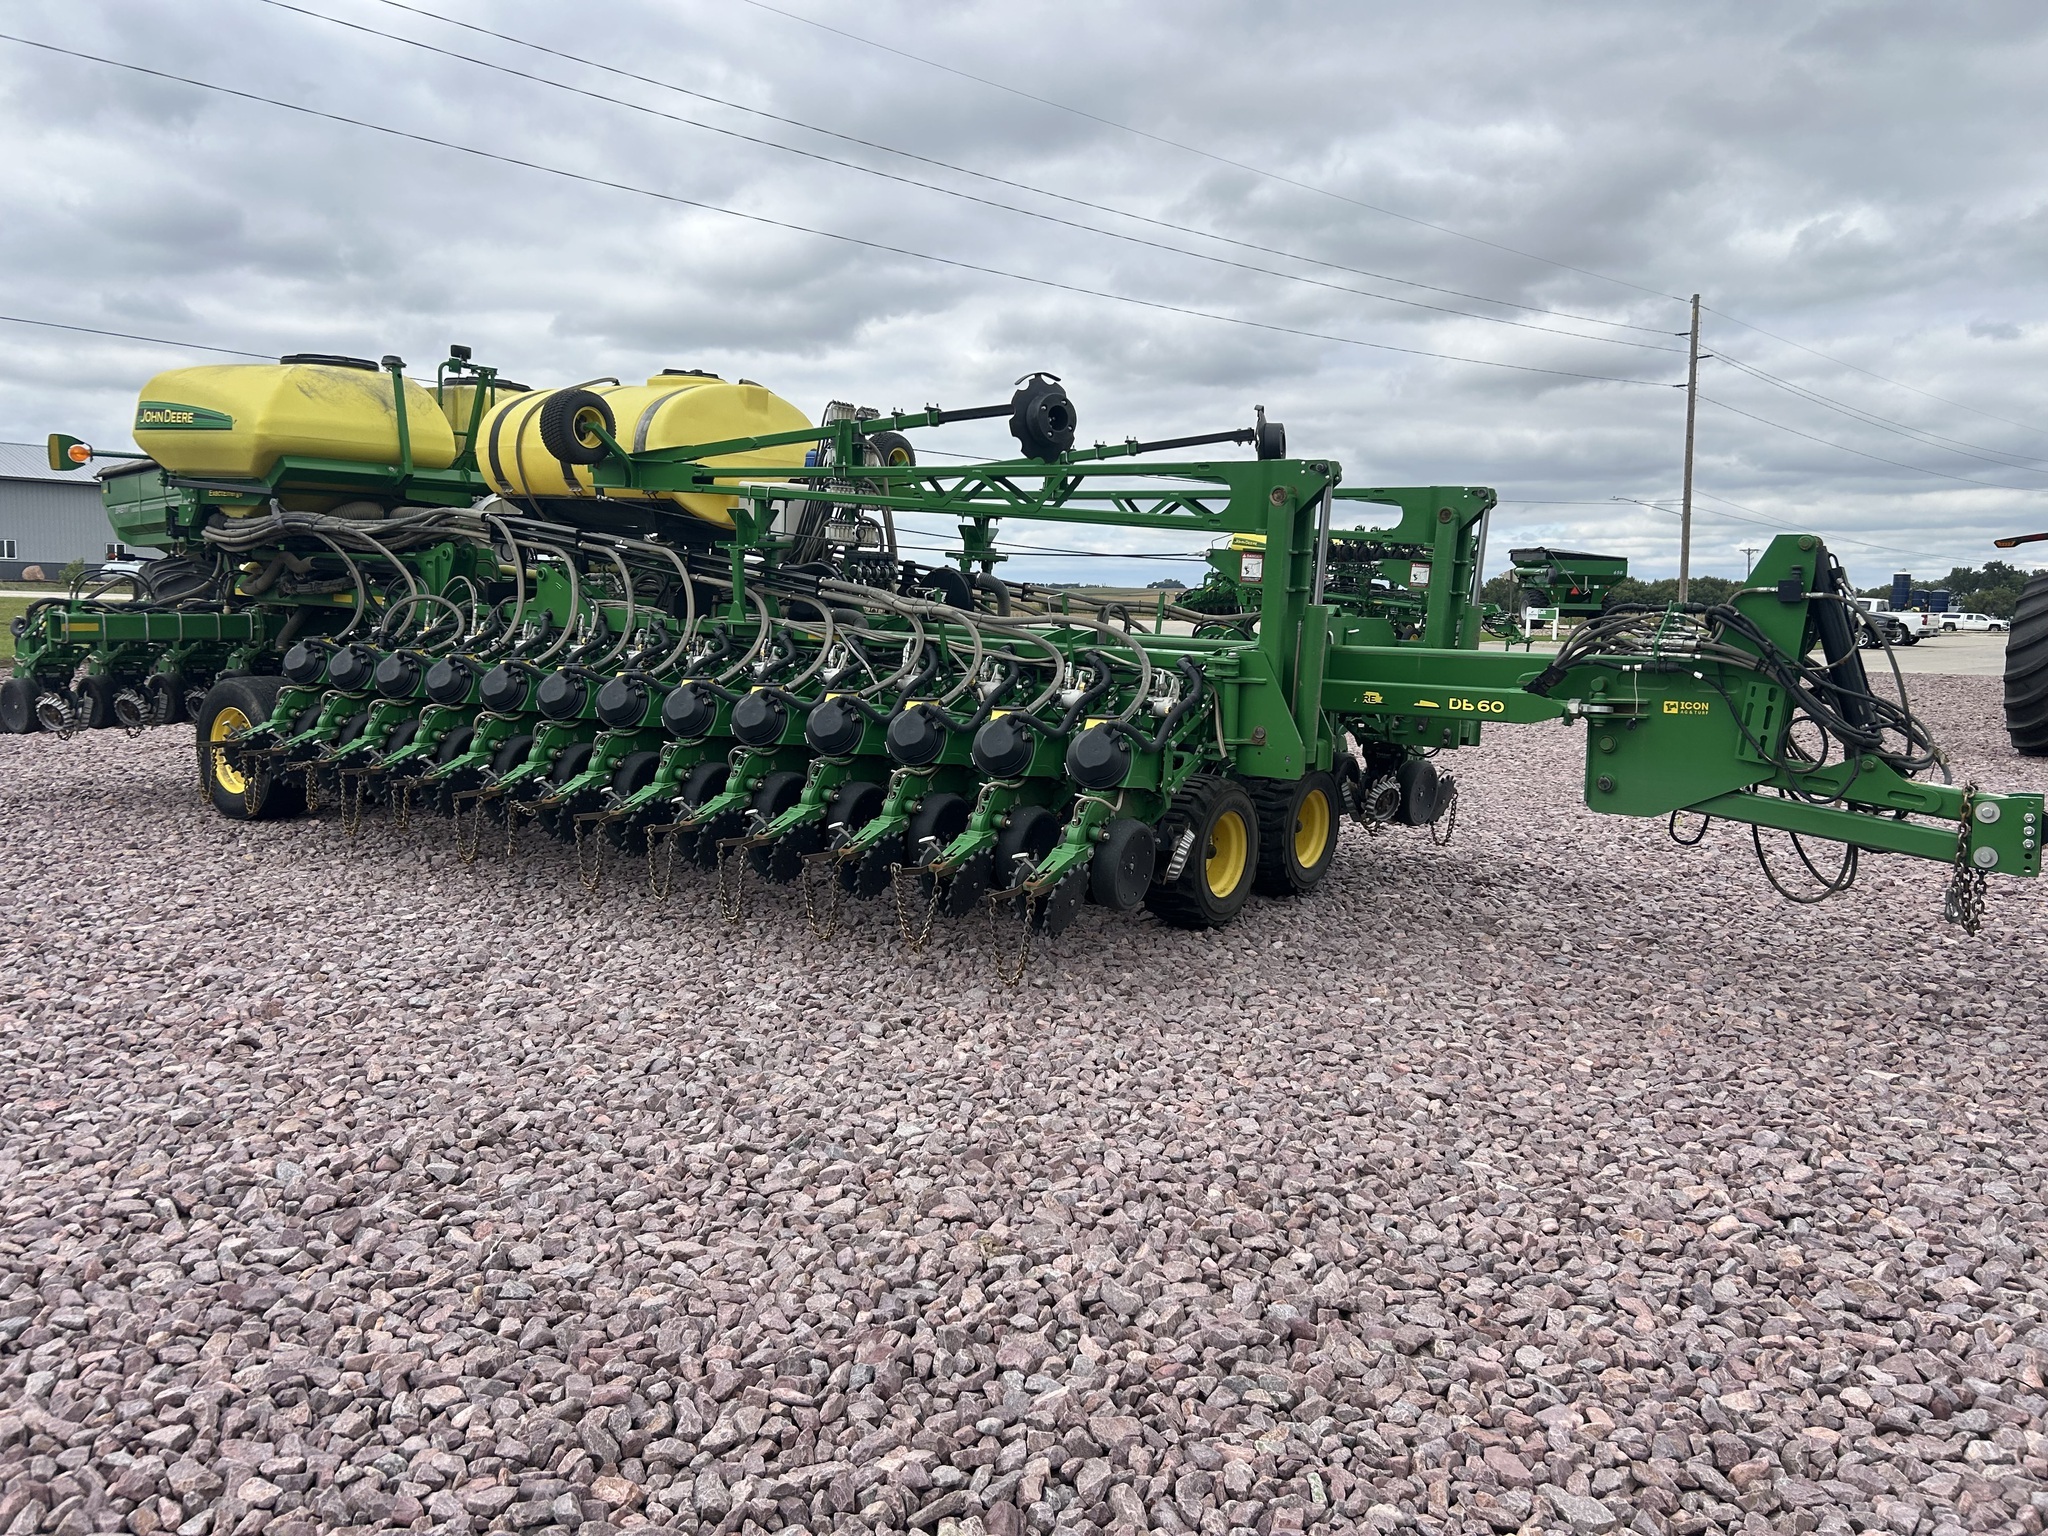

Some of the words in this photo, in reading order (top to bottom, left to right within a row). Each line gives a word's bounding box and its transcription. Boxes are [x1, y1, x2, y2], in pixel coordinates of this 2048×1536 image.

[140, 409, 164, 423] JOHN
[164, 409, 194, 423] DEERE
[1680, 701, 1709, 710] ICON
